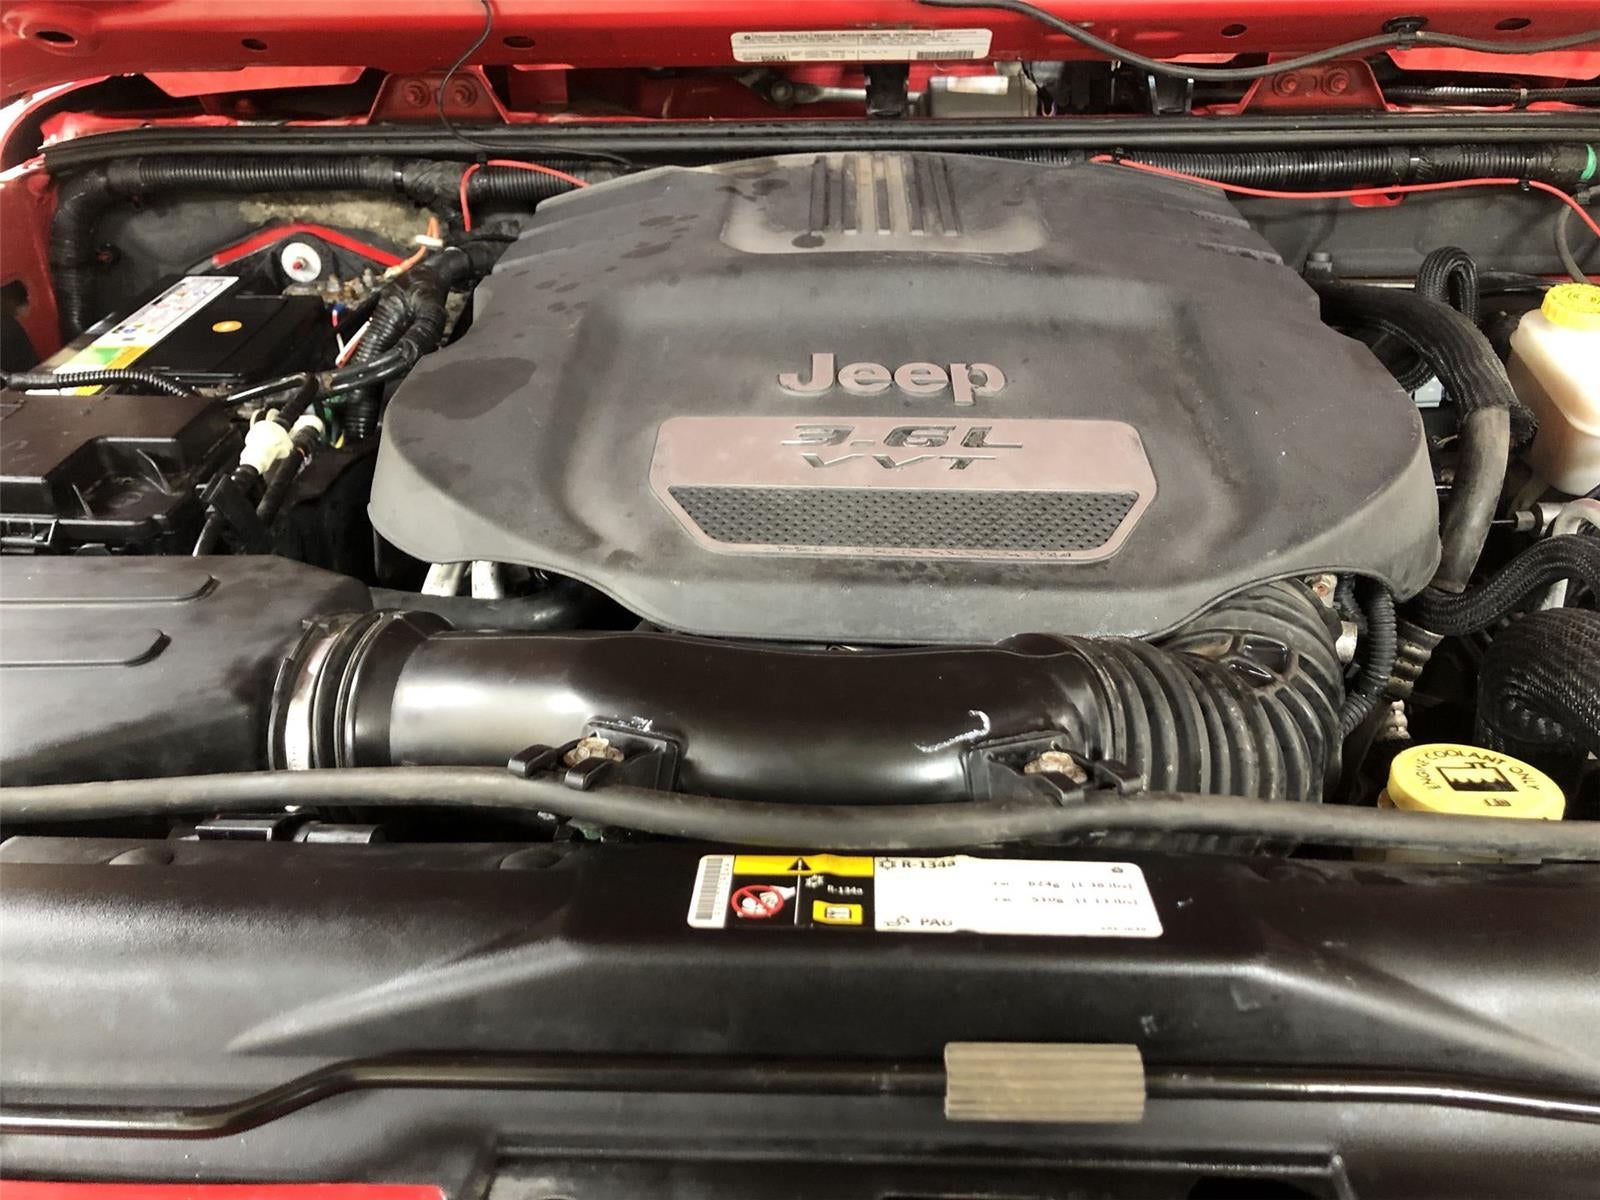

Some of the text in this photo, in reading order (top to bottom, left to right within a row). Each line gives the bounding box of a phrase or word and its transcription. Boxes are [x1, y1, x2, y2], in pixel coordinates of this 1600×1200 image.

[778, 352, 1007, 406] Jeep
[781, 424, 1023, 449] 3.6L
[801, 453, 997, 470] VVT
[1424, 749, 1507, 766] COOLANT
[1508, 766, 1540, 791] ONLY
[902, 860, 956, 869] R-134a
[827, 884, 864, 896] R-134a
